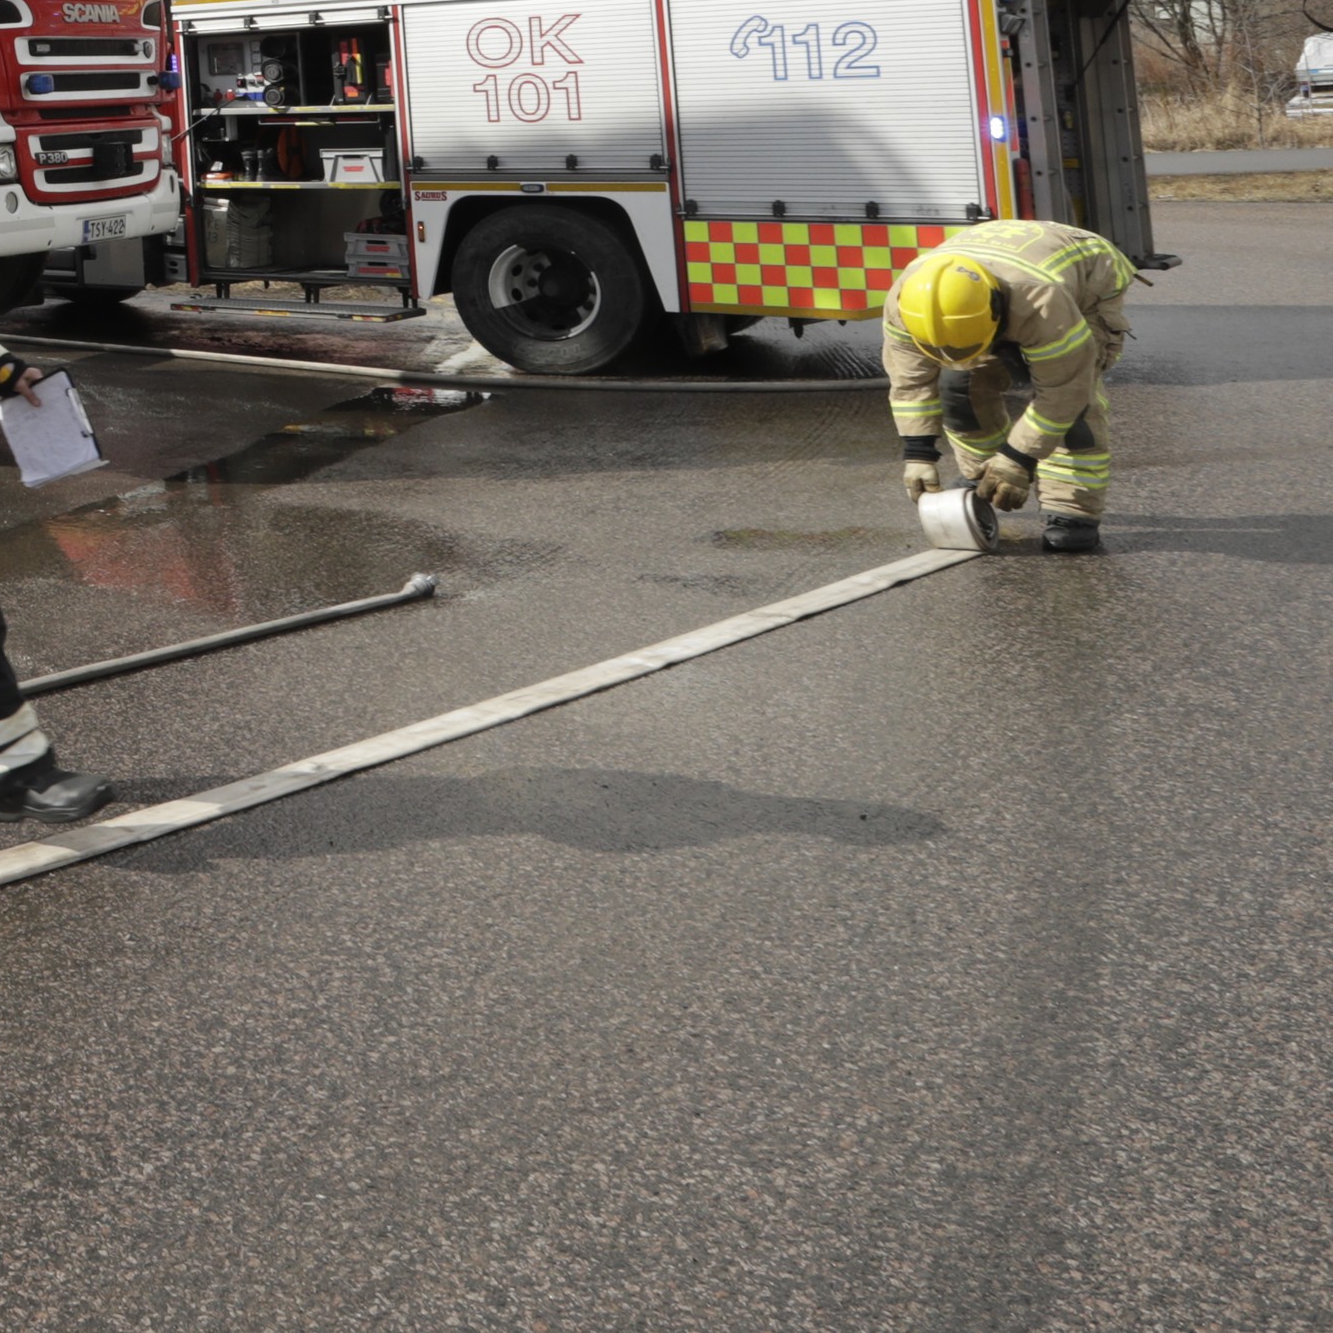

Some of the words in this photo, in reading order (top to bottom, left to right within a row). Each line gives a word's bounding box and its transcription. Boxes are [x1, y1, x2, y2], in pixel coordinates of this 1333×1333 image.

[62, 3, 121, 23] SCANIA
[466, 14, 584, 68] OK
[758, 21, 880, 80] 112
[473, 71, 582, 123] 101
[90, 218, 126, 239] TSY-422
